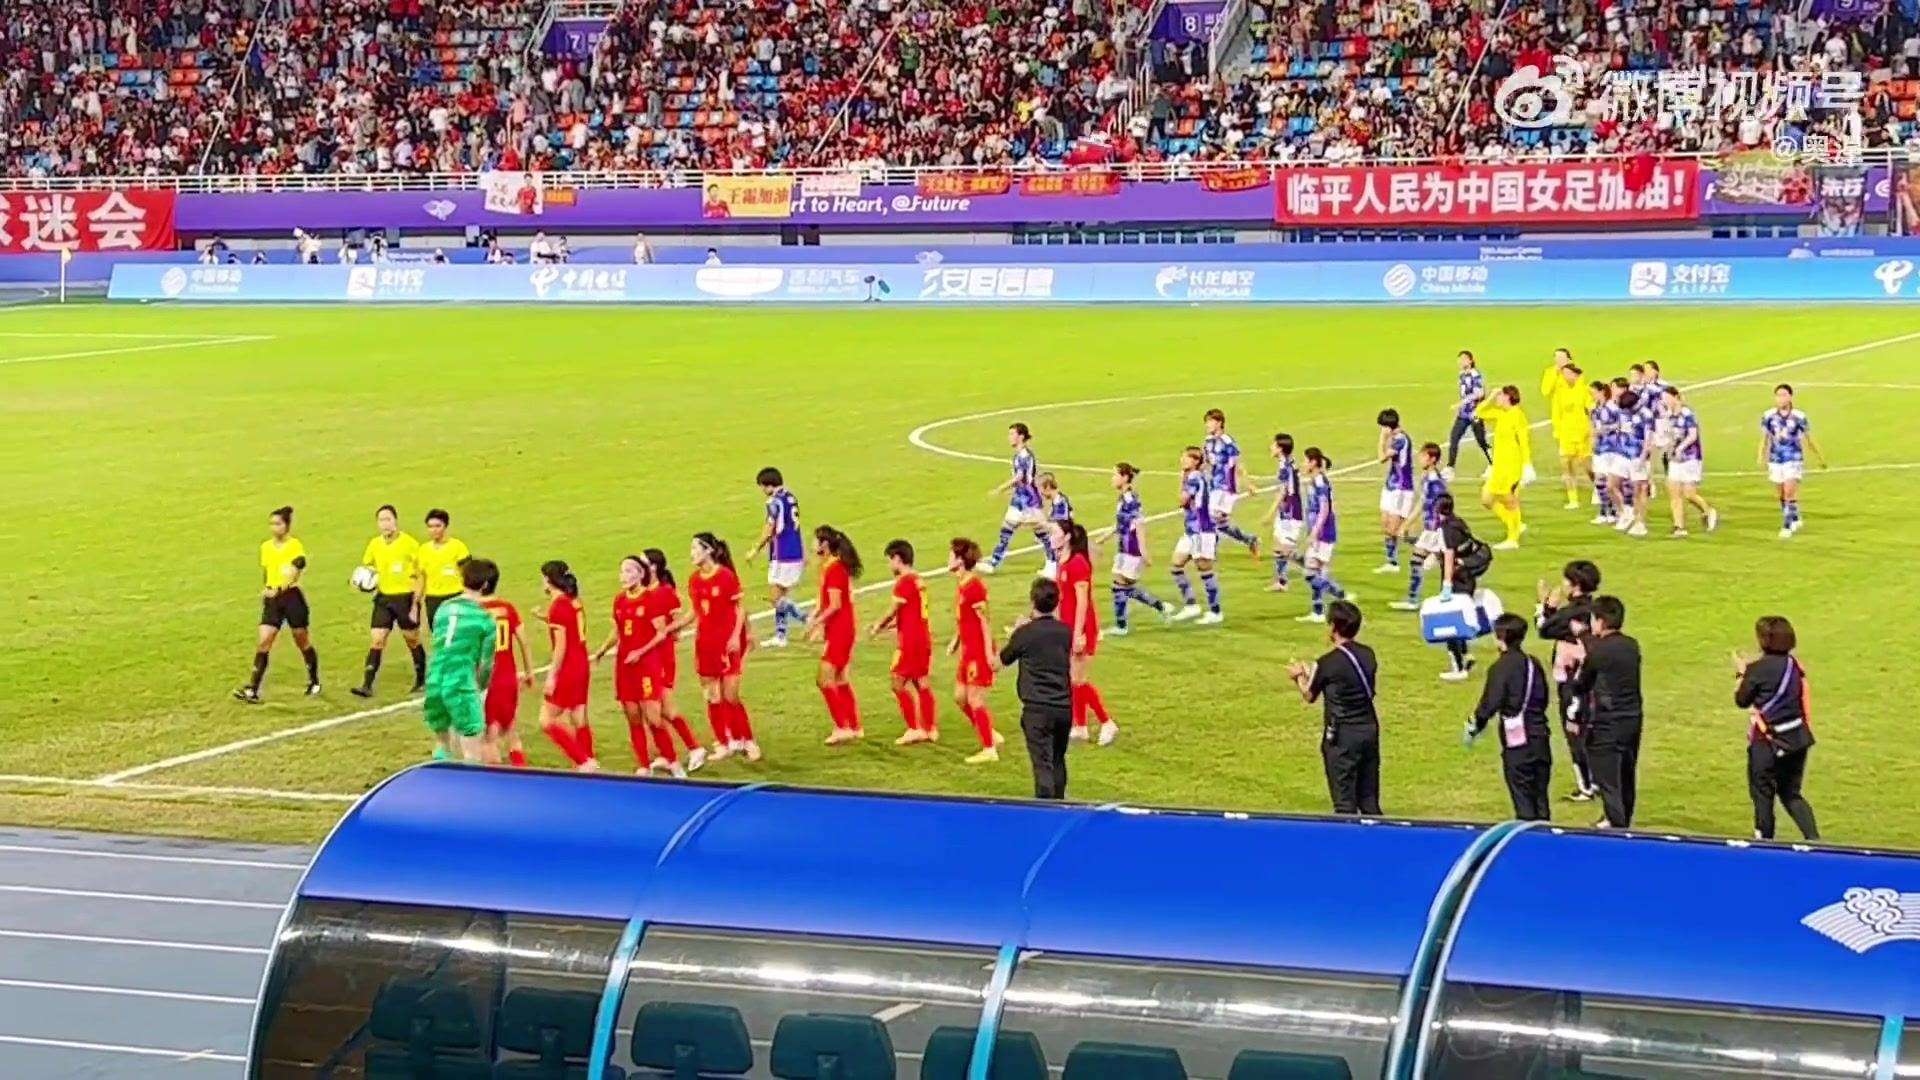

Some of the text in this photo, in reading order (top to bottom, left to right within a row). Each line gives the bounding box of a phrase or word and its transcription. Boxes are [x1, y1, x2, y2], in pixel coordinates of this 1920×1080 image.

[570, 34, 580, 49] 7
[1287, 168, 1685, 215] 临平人民为中国女足加油!
[811, 198, 830, 212] to
[833, 195, 888, 215] Heart,
[892, 195, 970, 212] @Future
[0, 192, 147, 250] 迷会
[1421, 265, 1488, 283] 中国移动
[1671, 263, 1732, 284] 支付宝
